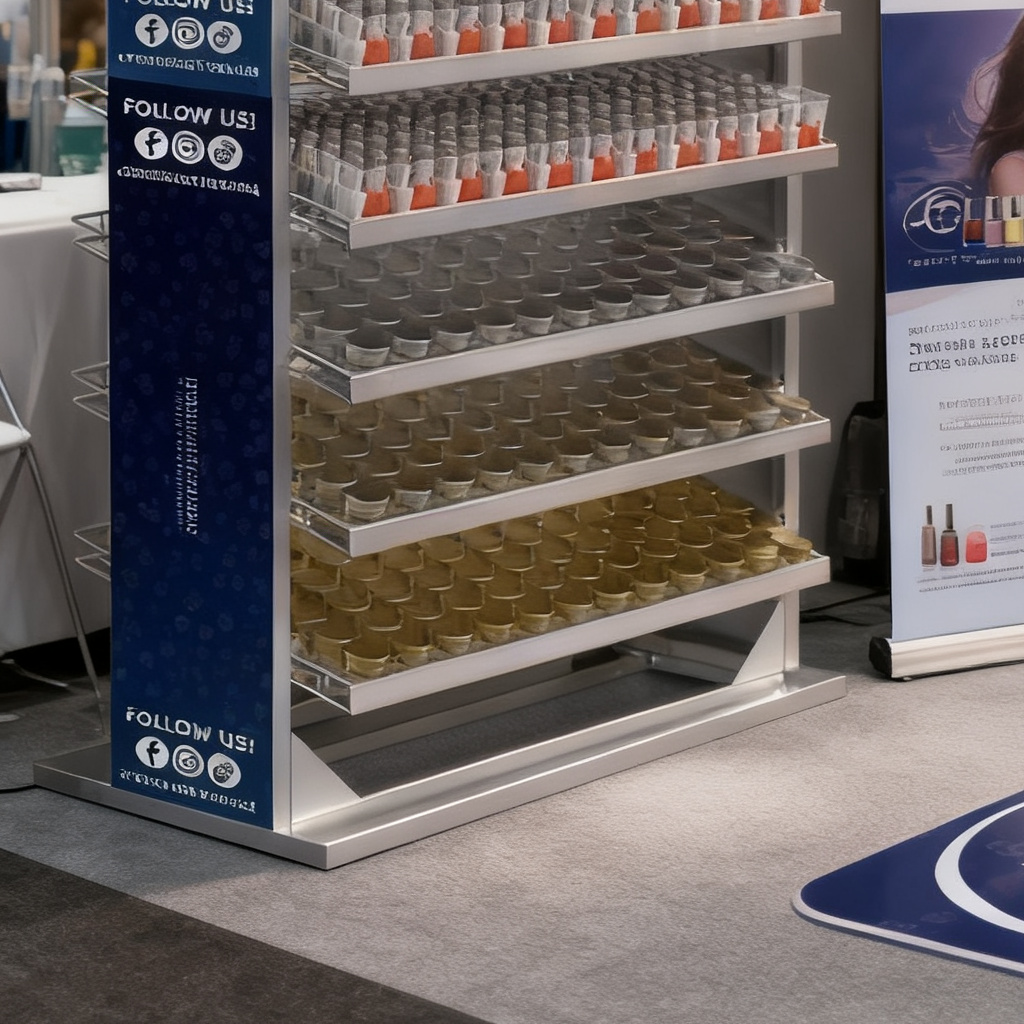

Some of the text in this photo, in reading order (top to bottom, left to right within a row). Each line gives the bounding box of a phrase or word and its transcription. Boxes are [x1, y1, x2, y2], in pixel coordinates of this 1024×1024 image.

[123, 97, 213, 125] FOLLOW
[126, 706, 255, 754] FOLLOW US!
